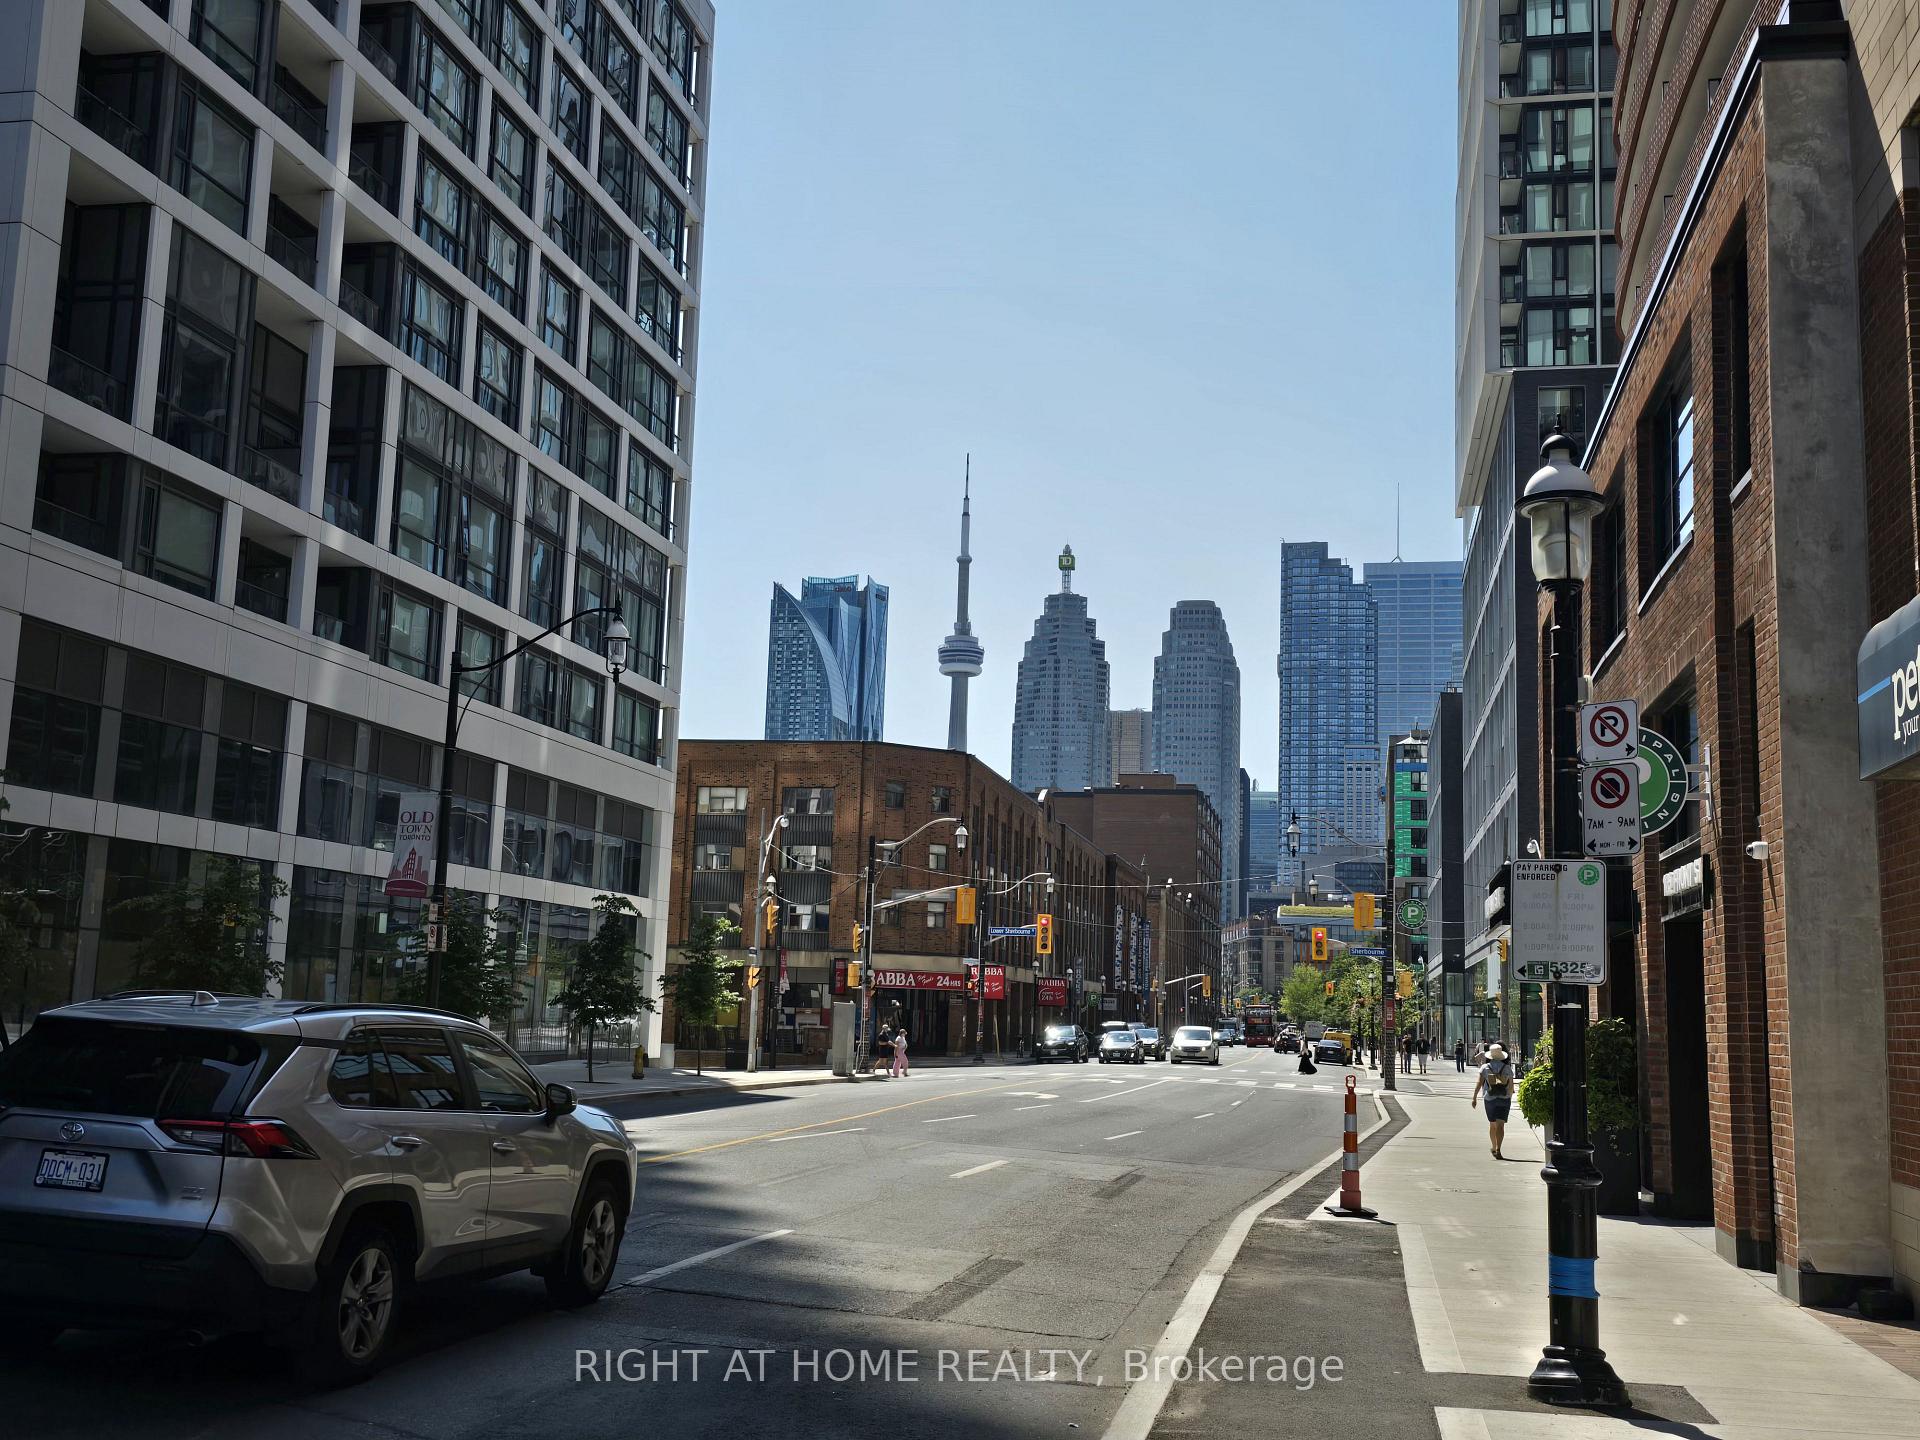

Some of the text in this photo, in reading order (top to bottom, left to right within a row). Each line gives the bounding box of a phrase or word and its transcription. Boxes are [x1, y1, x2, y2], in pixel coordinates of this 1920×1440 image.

[1060, 557, 1072, 565] TD
[400, 811, 434, 824] OLD
[1587, 818, 1604, 830] 7AM
[1617, 816, 1636, 827] 9AM
[400, 824, 432, 834] TOWN
[1516, 863, 1531, 871] PAY
[970, 967, 1003, 975] RBBA
[1550, 962, 1587, 974] 5325
[936, 975, 950, 987] 24
